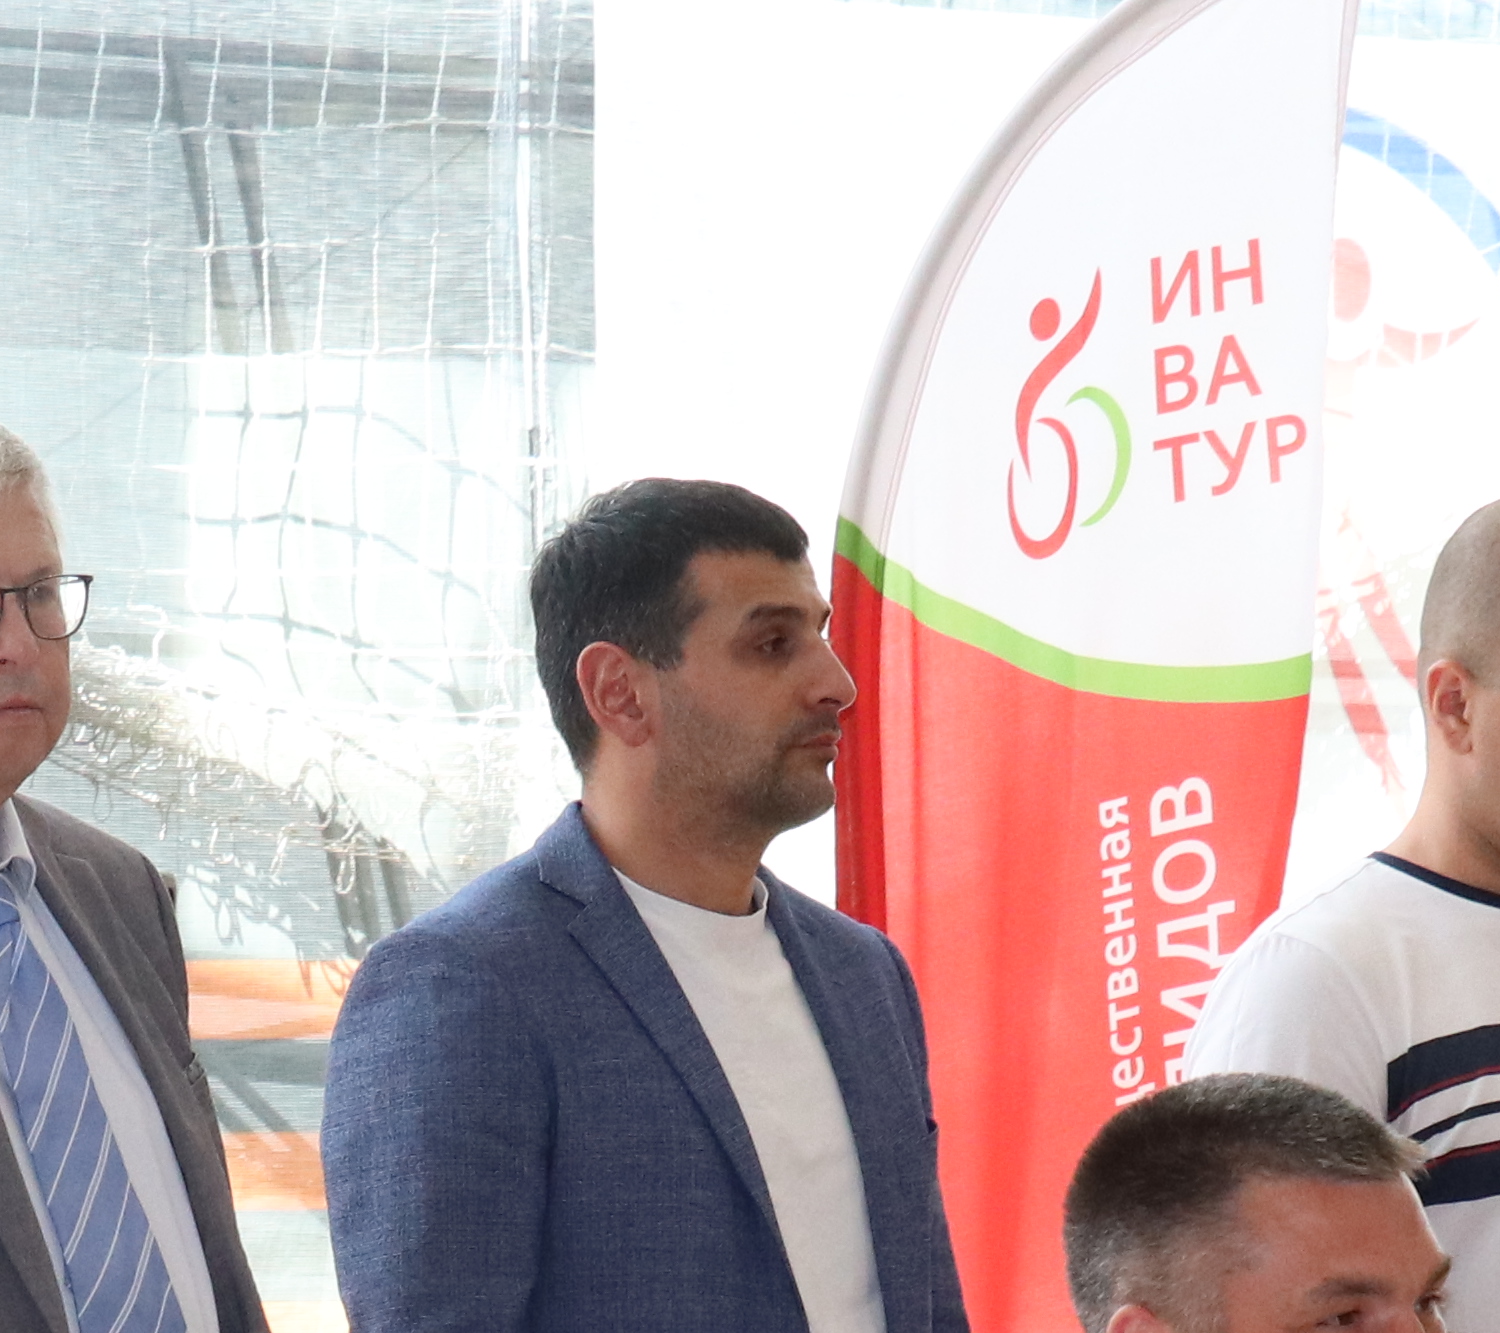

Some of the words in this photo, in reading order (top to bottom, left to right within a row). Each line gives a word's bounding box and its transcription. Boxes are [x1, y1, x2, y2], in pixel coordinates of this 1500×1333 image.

[1150, 238, 1264, 324] ИН
[1154, 334, 1263, 415] ВА
[1153, 414, 1307, 503] ТУР
